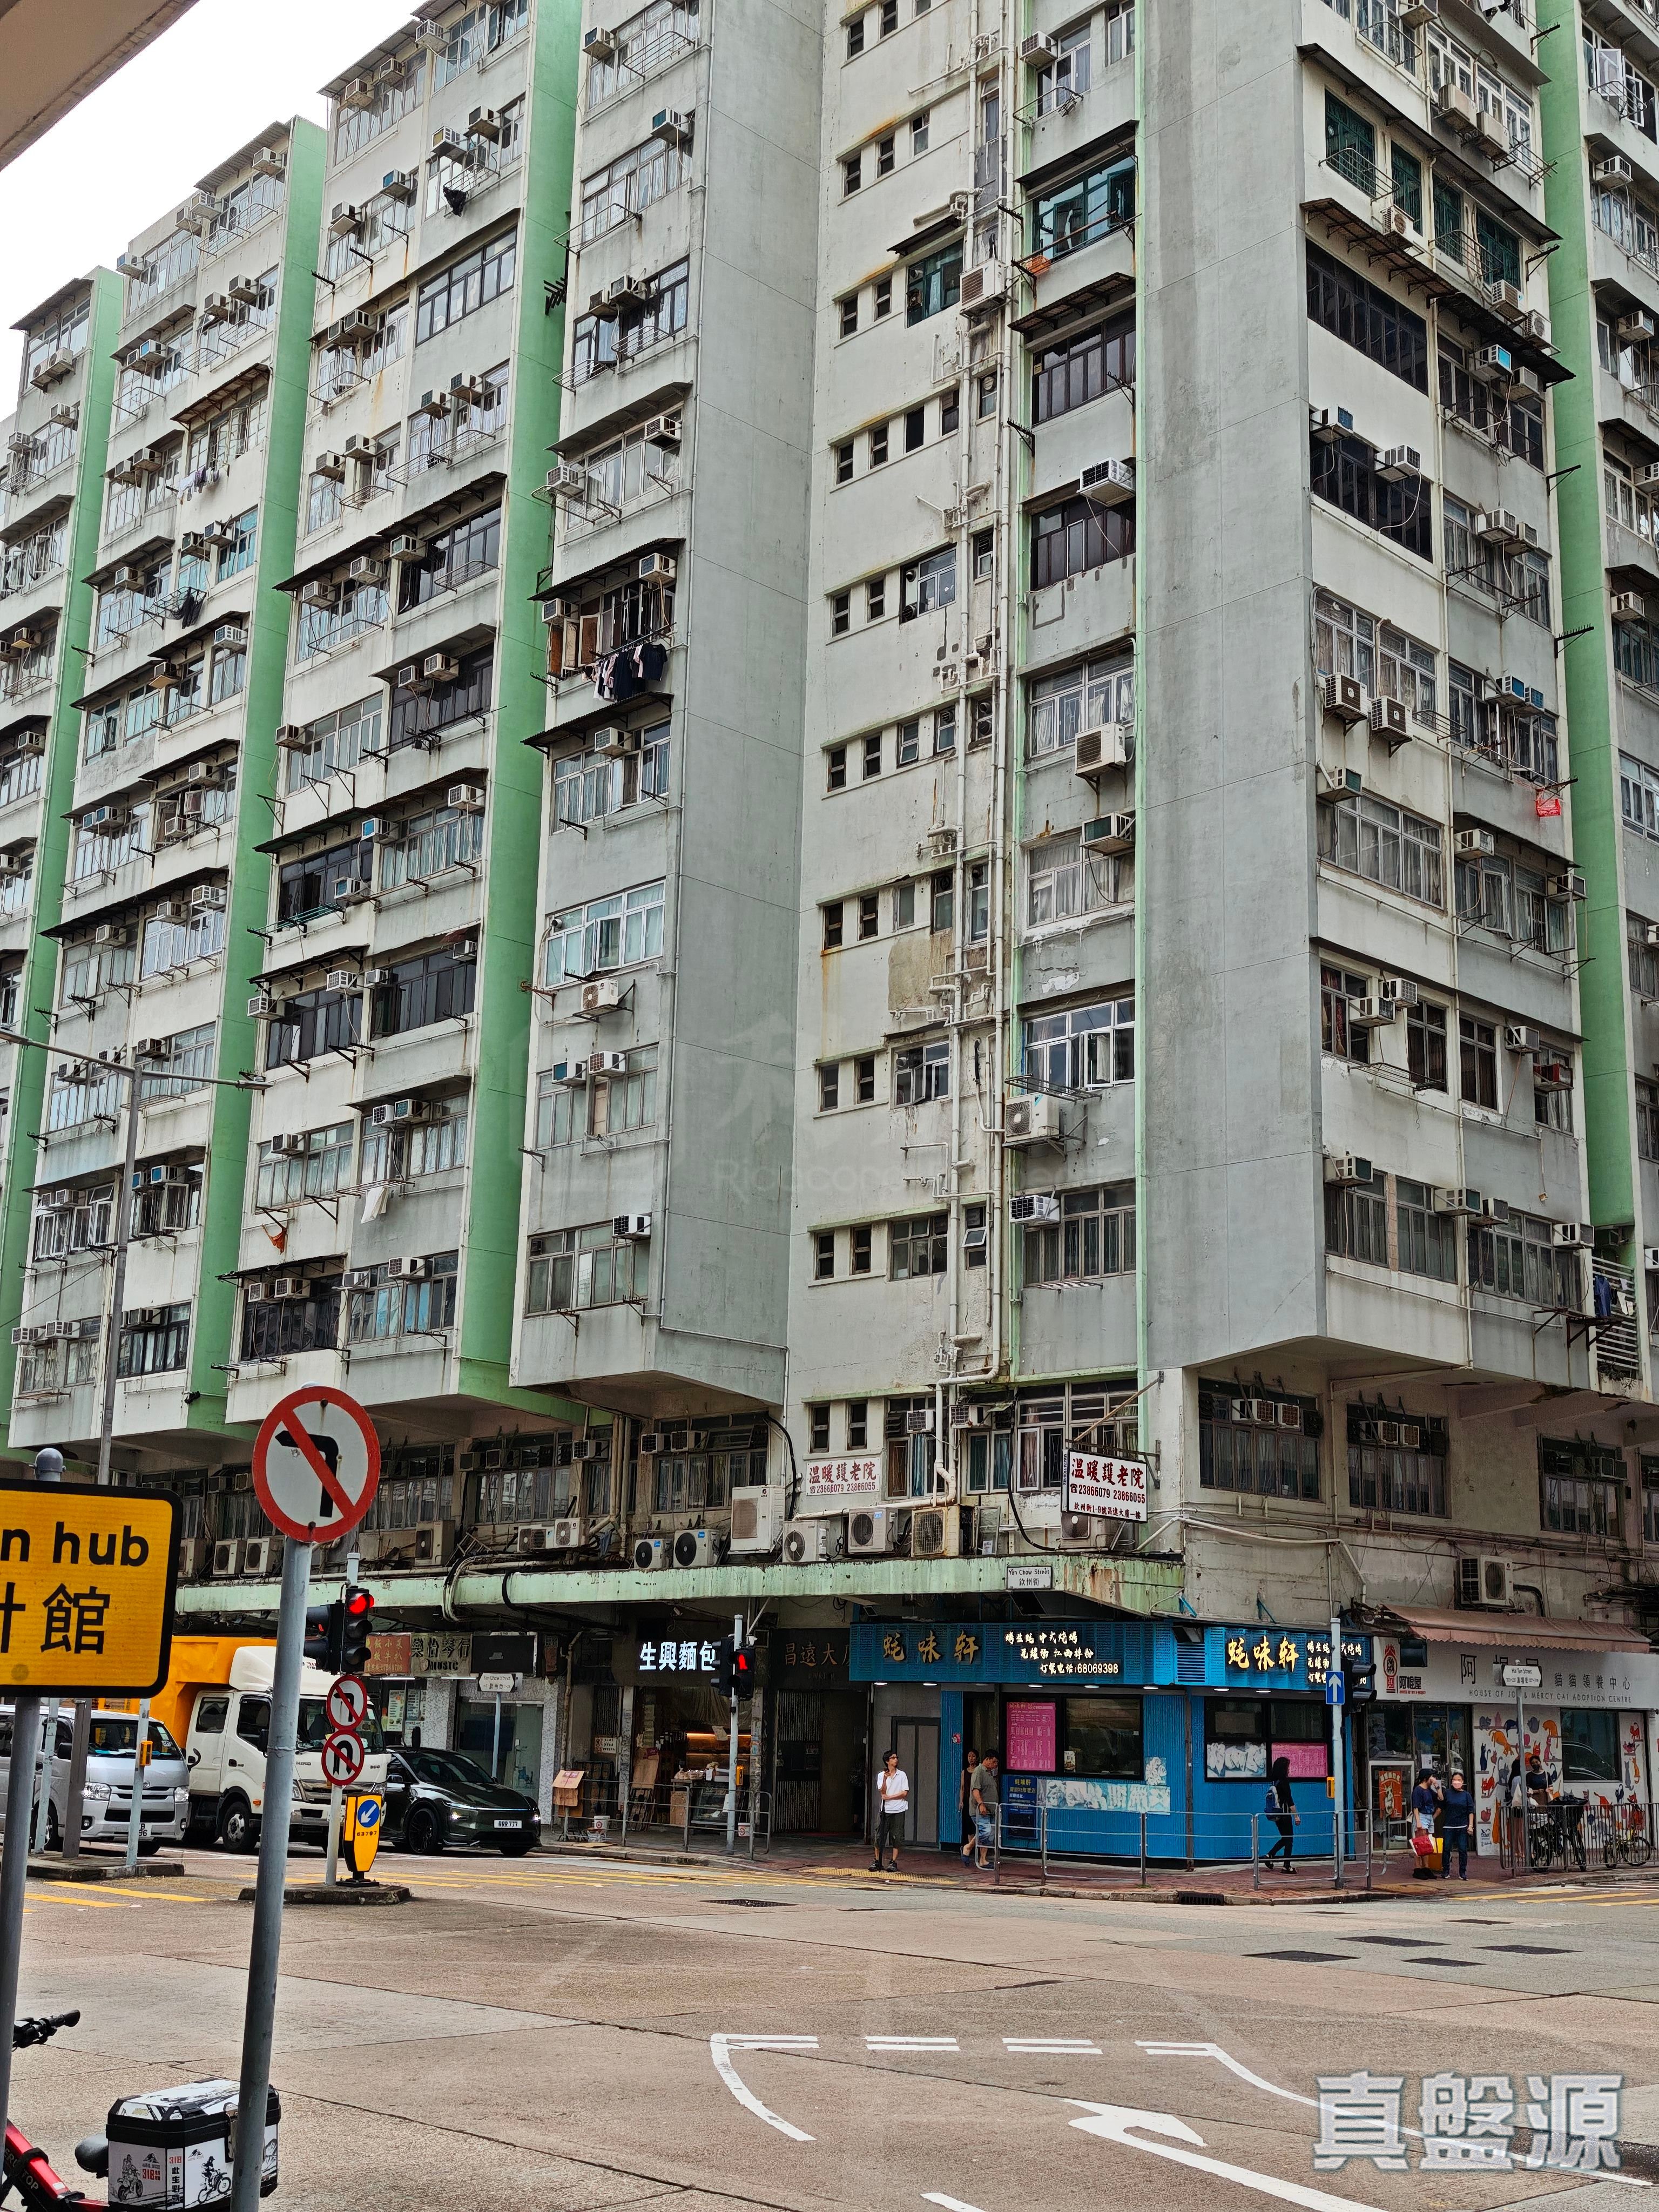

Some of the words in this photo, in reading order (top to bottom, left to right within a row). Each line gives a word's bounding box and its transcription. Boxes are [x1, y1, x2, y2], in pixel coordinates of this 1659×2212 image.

[817, 1484, 844, 1493] 23866079
[847, 1482, 875, 1491] 23866055
[1079, 1484, 1110, 1498] 23866079
[1114, 1489, 1145, 1503] 23866055
[53, 1521, 149, 1567] hub
[639, 1640, 716, 1671] 生興麵包
[883, 1629, 979, 1664] 蚝味轩
[1228, 1635, 1299, 1673] 蚝味轩
[1469, 1689, 1492, 1697] HOUSE
[1573, 1694, 1605, 1702] ADOPTION
[1608, 1695, 1631, 1703] CENTRE
